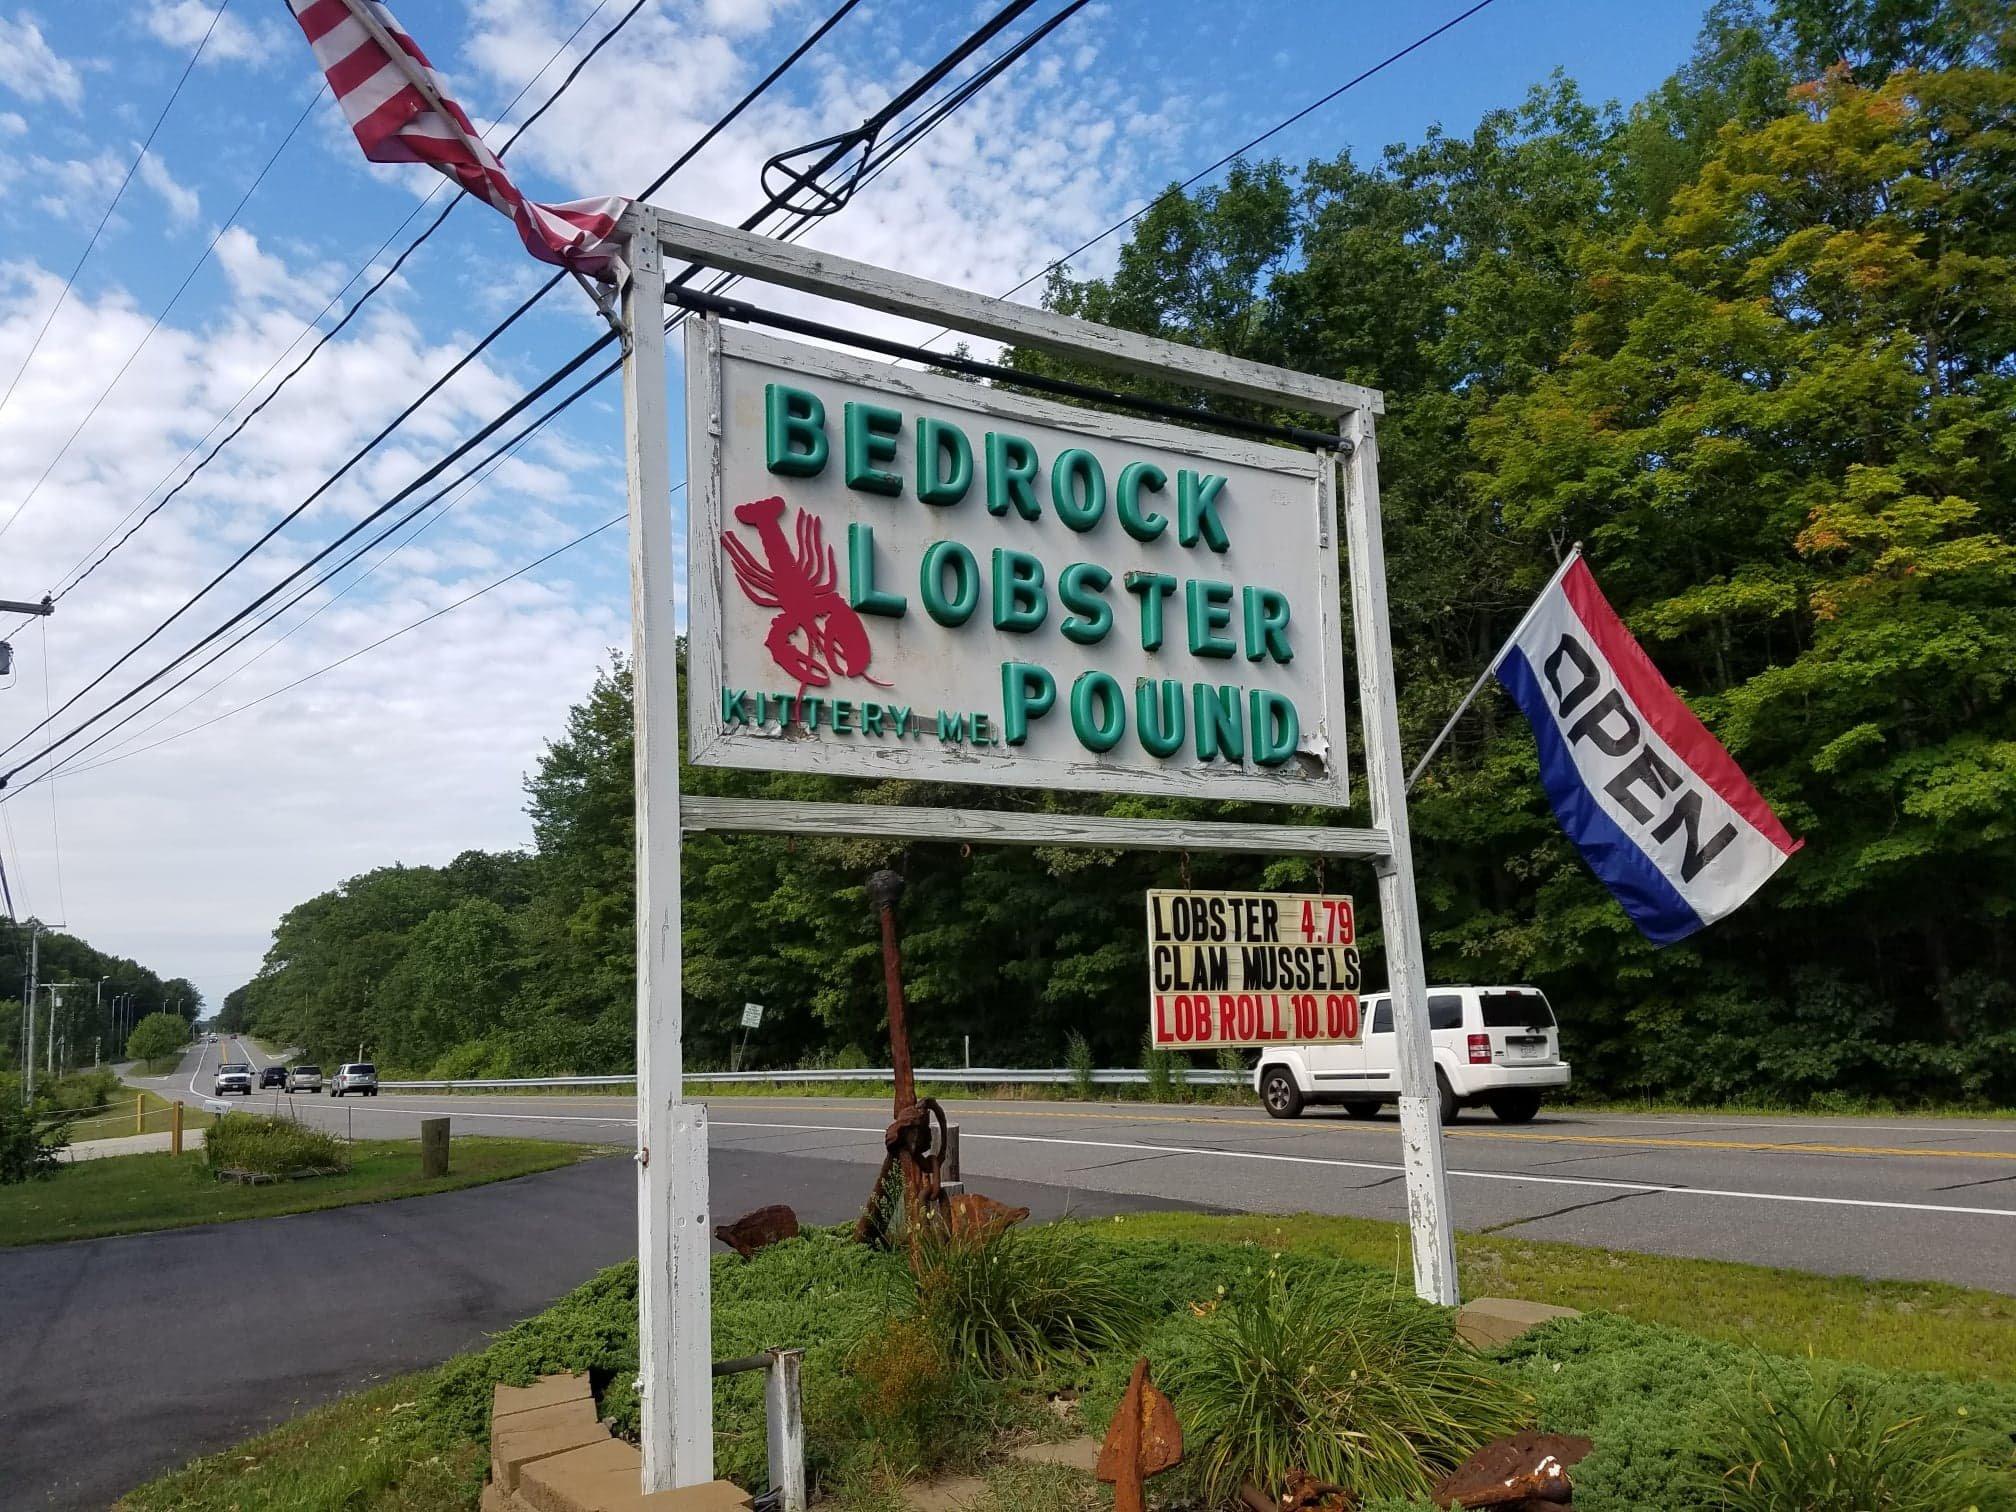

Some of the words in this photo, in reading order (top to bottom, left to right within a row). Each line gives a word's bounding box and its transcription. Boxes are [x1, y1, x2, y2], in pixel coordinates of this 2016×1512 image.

[765, 383, 1229, 553] BEDROCK
[847, 521, 1294, 664] LOBSTER
[1001, 661, 1300, 766] POUND
[1543, 632, 1739, 884] OPEN
[1152, 895, 1279, 943] LOBSTER
[1301, 900, 1353, 944] 4.79
[1154, 945, 1228, 991] CLAM
[1242, 945, 1361, 991] MUSSELS
[1156, 994, 1213, 1043] LOB
[1219, 994, 1288, 1041] ROLL
[1290, 994, 1358, 1039] 10.00
